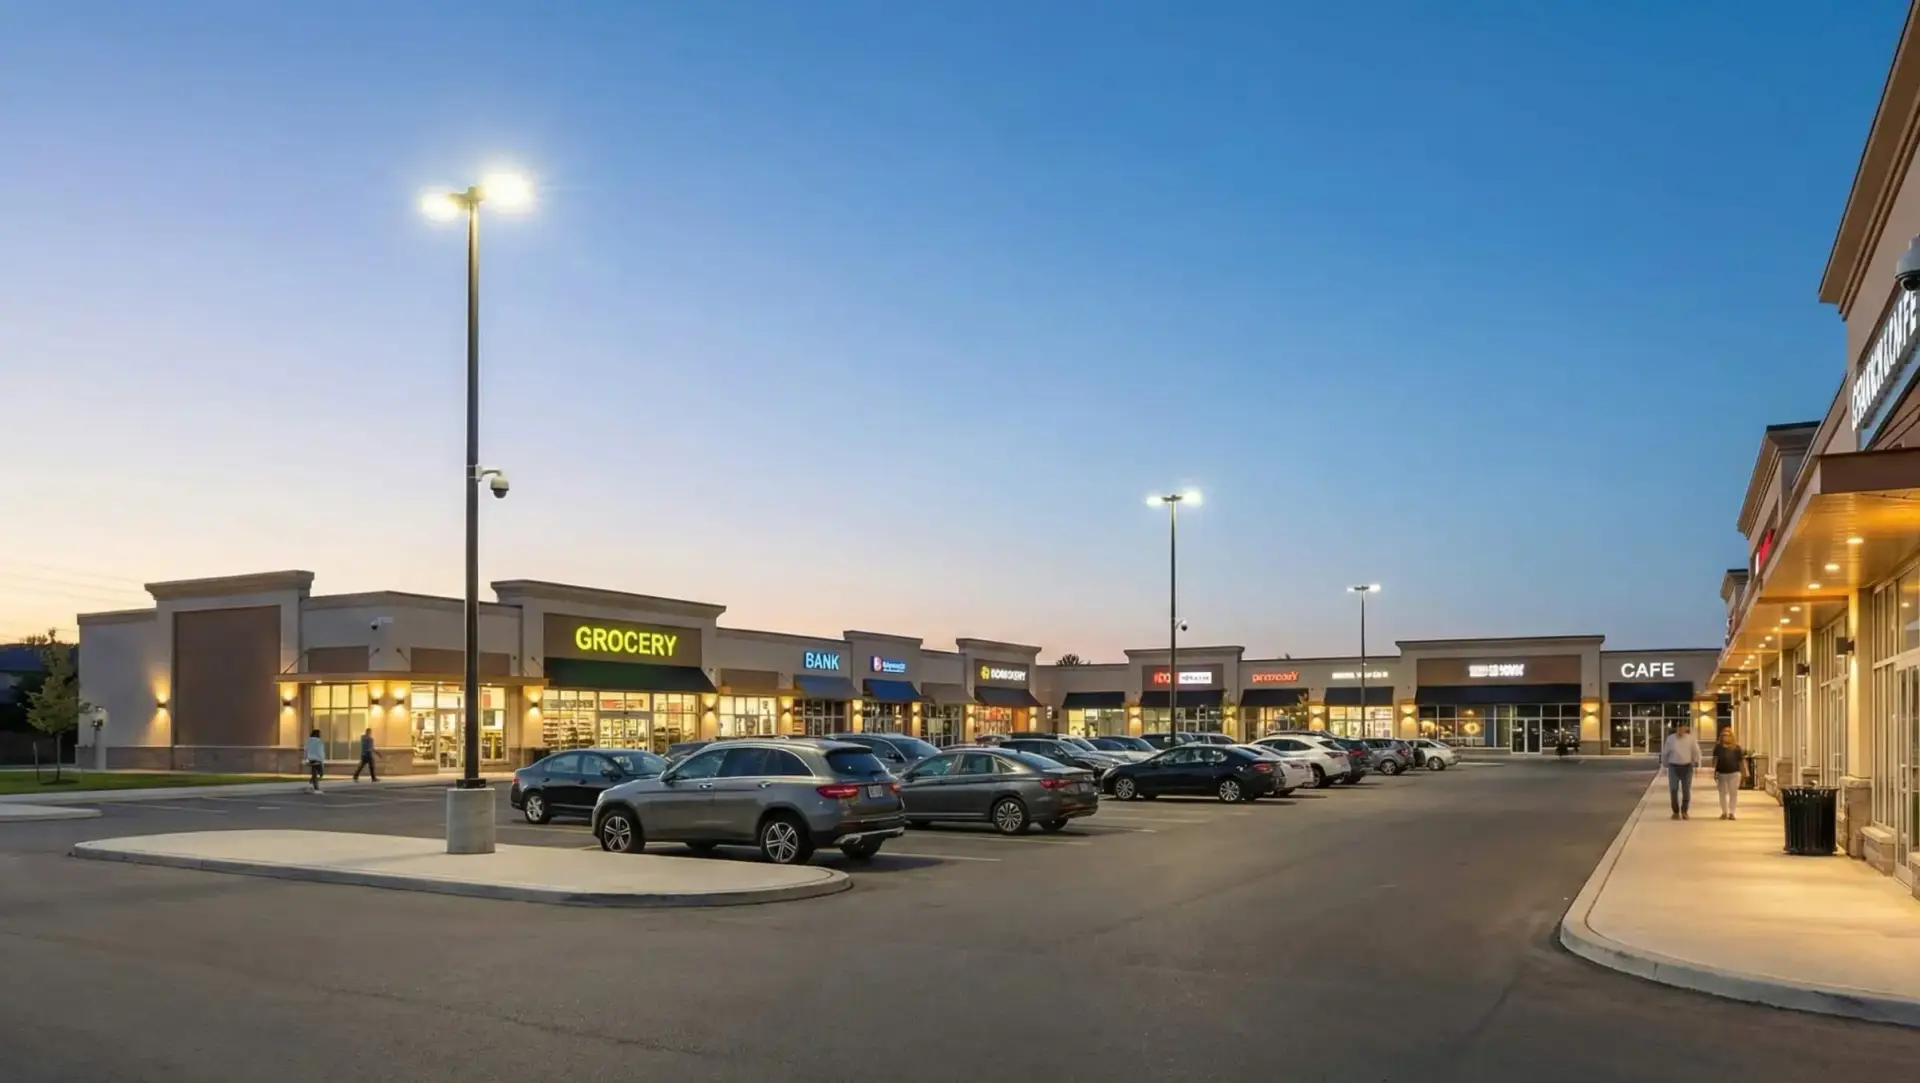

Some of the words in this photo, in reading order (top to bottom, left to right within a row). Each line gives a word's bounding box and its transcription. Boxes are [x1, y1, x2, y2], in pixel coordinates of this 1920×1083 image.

[575, 626, 677, 657] GROCERY
[805, 652, 840, 670] BANK
[1621, 662, 1675, 678] CAFE
